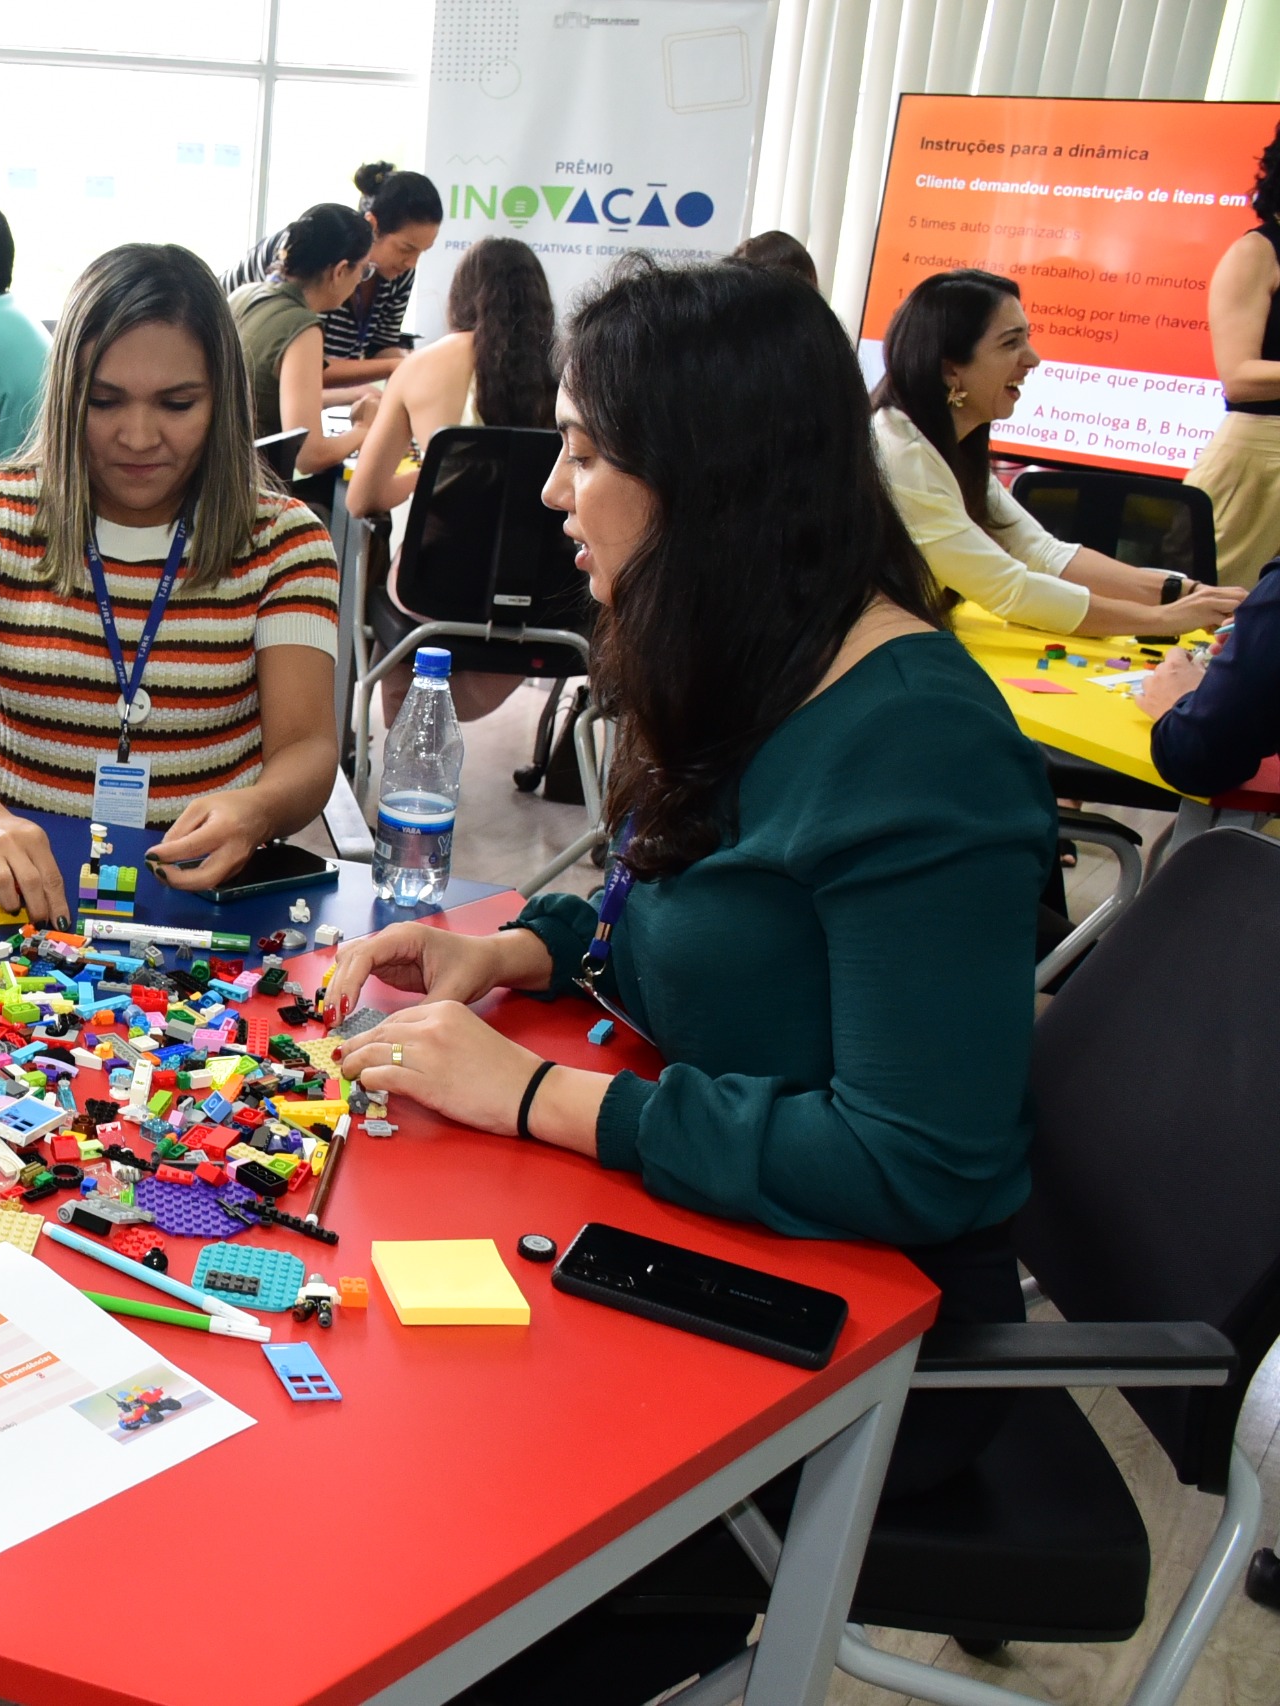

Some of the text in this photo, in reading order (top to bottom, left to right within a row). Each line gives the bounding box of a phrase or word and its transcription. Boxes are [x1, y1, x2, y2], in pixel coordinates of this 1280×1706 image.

[920, 136, 1149, 161] Instruções para a dinâmica
[555, 158, 613, 175] PRÊMIO
[915, 174, 966, 190] Cliente
[969, 178, 1049, 196] demandou
[1053, 184, 1144, 203] construção
[1147, 188, 1169, 202] de
[1172, 188, 1215, 205] itens
[1218, 194, 1246, 206] em
[449, 183, 714, 232] INOVAÇÃO
[908, 215, 1081, 241] 5 times auto organizados
[585, 245, 593, 255] E
[902, 252, 1207, 291] 4 rodadas (dias de trabalho) de 10 minutos
[1031, 301, 1086, 321] backlog
[1089, 309, 1116, 323] por
[1118, 310, 1151, 326] time
[1048, 322, 1119, 344] backlogs)
[1044, 366, 1101, 384] equipe
[1106, 374, 1139, 389] que
[1143, 378, 1207, 396] poderá
[1033, 404, 1044, 418] A
[1050, 406, 1130, 431] homologa
[1136, 417, 1152, 436] B,
[1160, 420, 1170, 435] B
[990, 421, 1058, 442] omologa
[1064, 428, 1080, 446] D,
[1087, 432, 1099, 446] D
[1104, 434, 1186, 461] homologa
[158, 574, 172, 598] TJRR
[100, 600, 111, 625] TJRR
[138, 634, 151, 658] TJRR
[729, 1289, 773, 1306] SAMSUNG
[4, 1352, 53, 1381] Dependências
